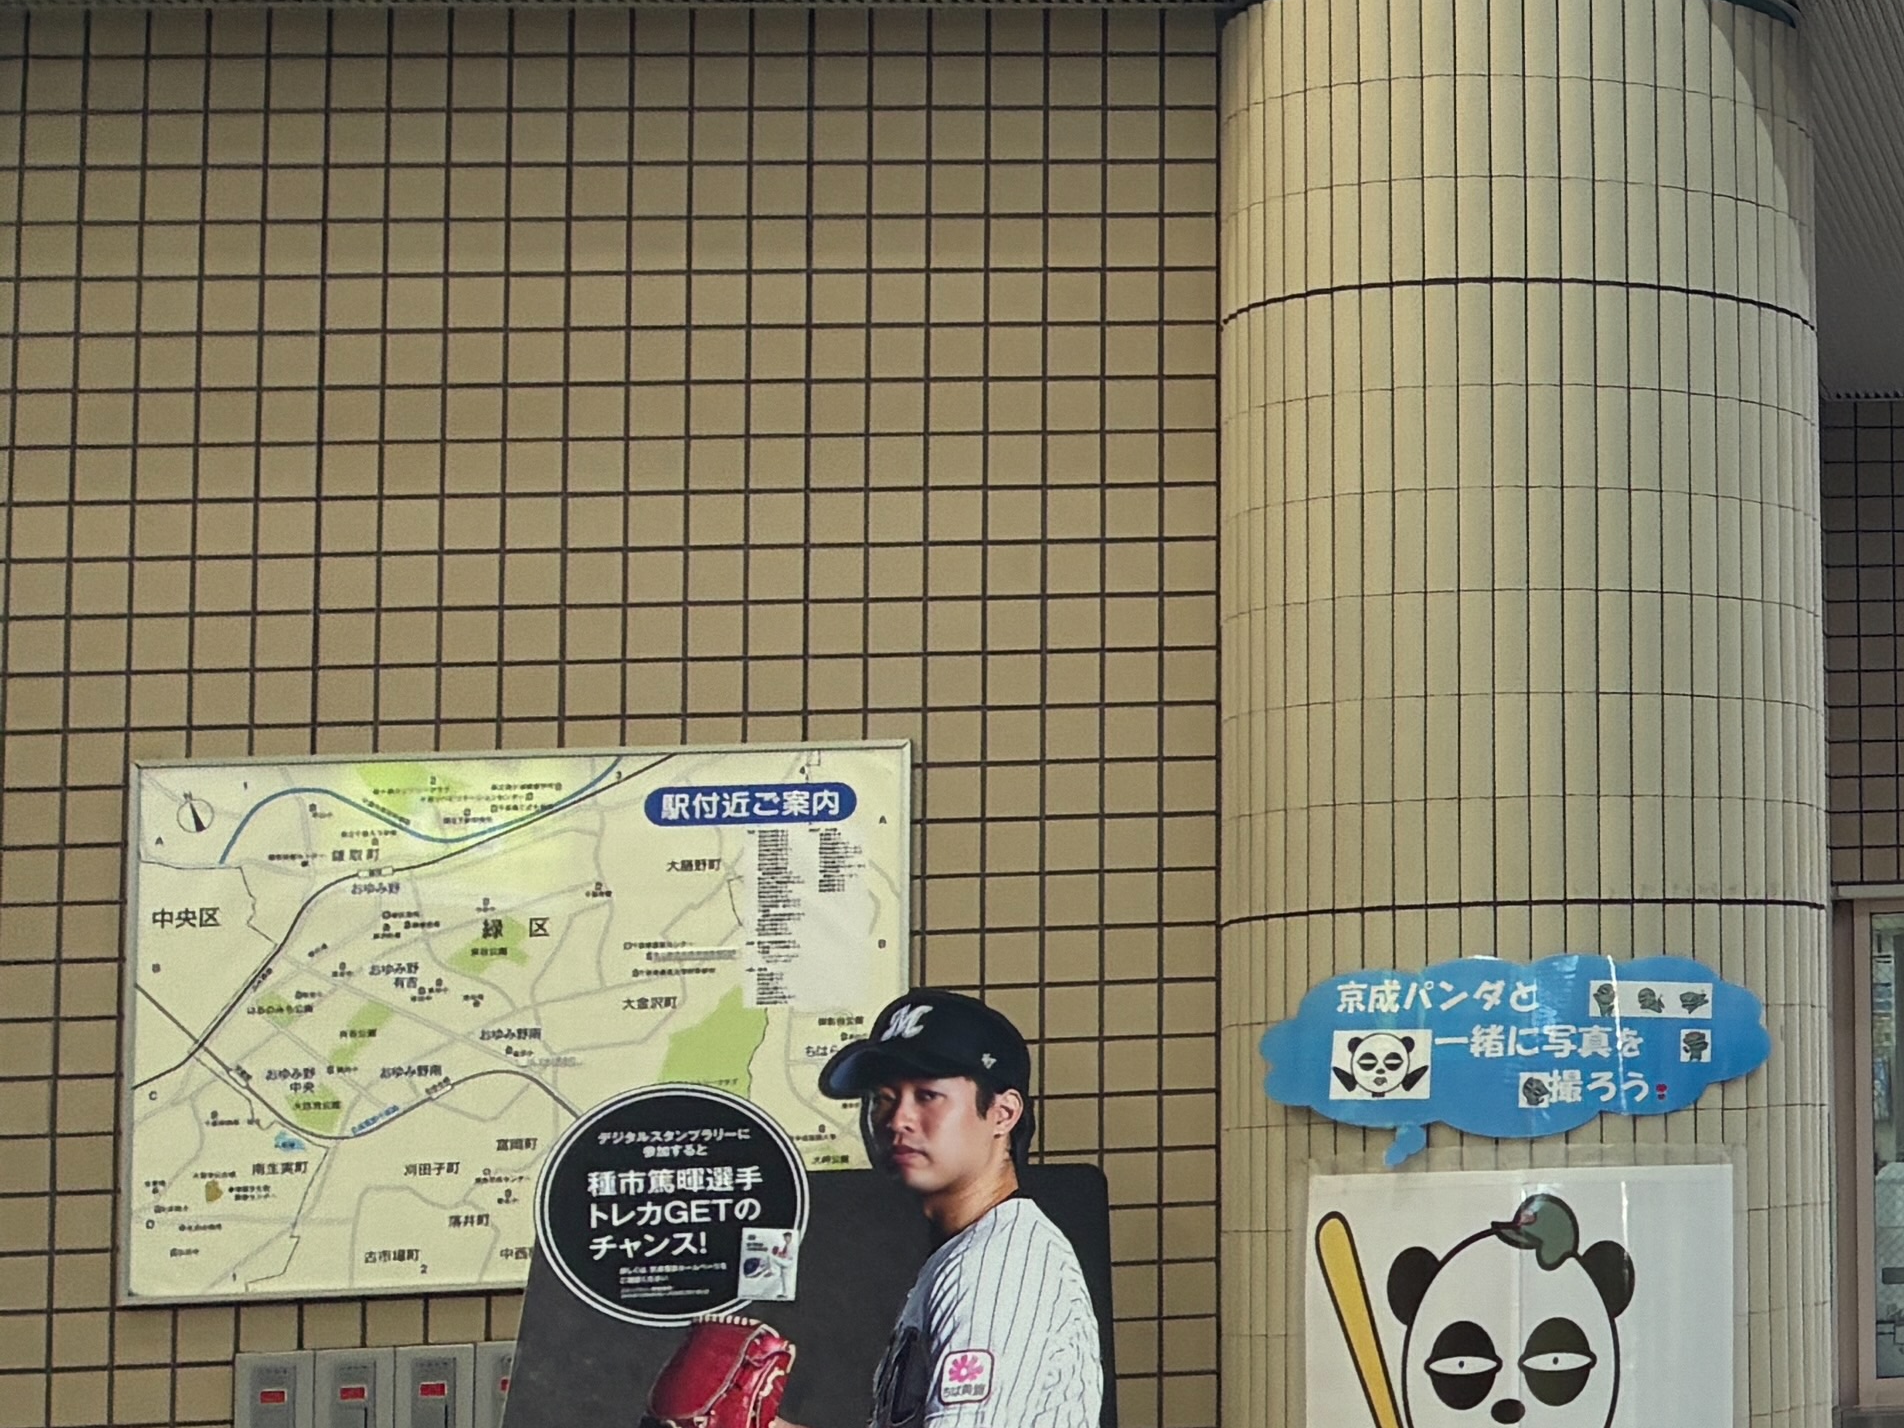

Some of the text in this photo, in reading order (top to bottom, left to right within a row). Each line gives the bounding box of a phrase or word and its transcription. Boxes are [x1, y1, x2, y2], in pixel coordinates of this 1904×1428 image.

[660, 789, 840, 821] 駅付近ご案内
[151, 906, 221, 929] 中央区
[1335, 980, 1542, 1014] 京成パンダと
[1433, 1023, 1645, 1060] 一緒に写真を
[148, 1091, 158, 1101] C
[289, 1082, 315, 1094] 中央
[597, 1128, 751, 1145] デジタルスタンプラリーに
[587, 1165, 764, 1197] 種市篤暉選手
[589, 1198, 762, 1229] トレカGETの
[499, 1246, 533, 1260] 中西
[588, 1231, 708, 1261] チャンス!
